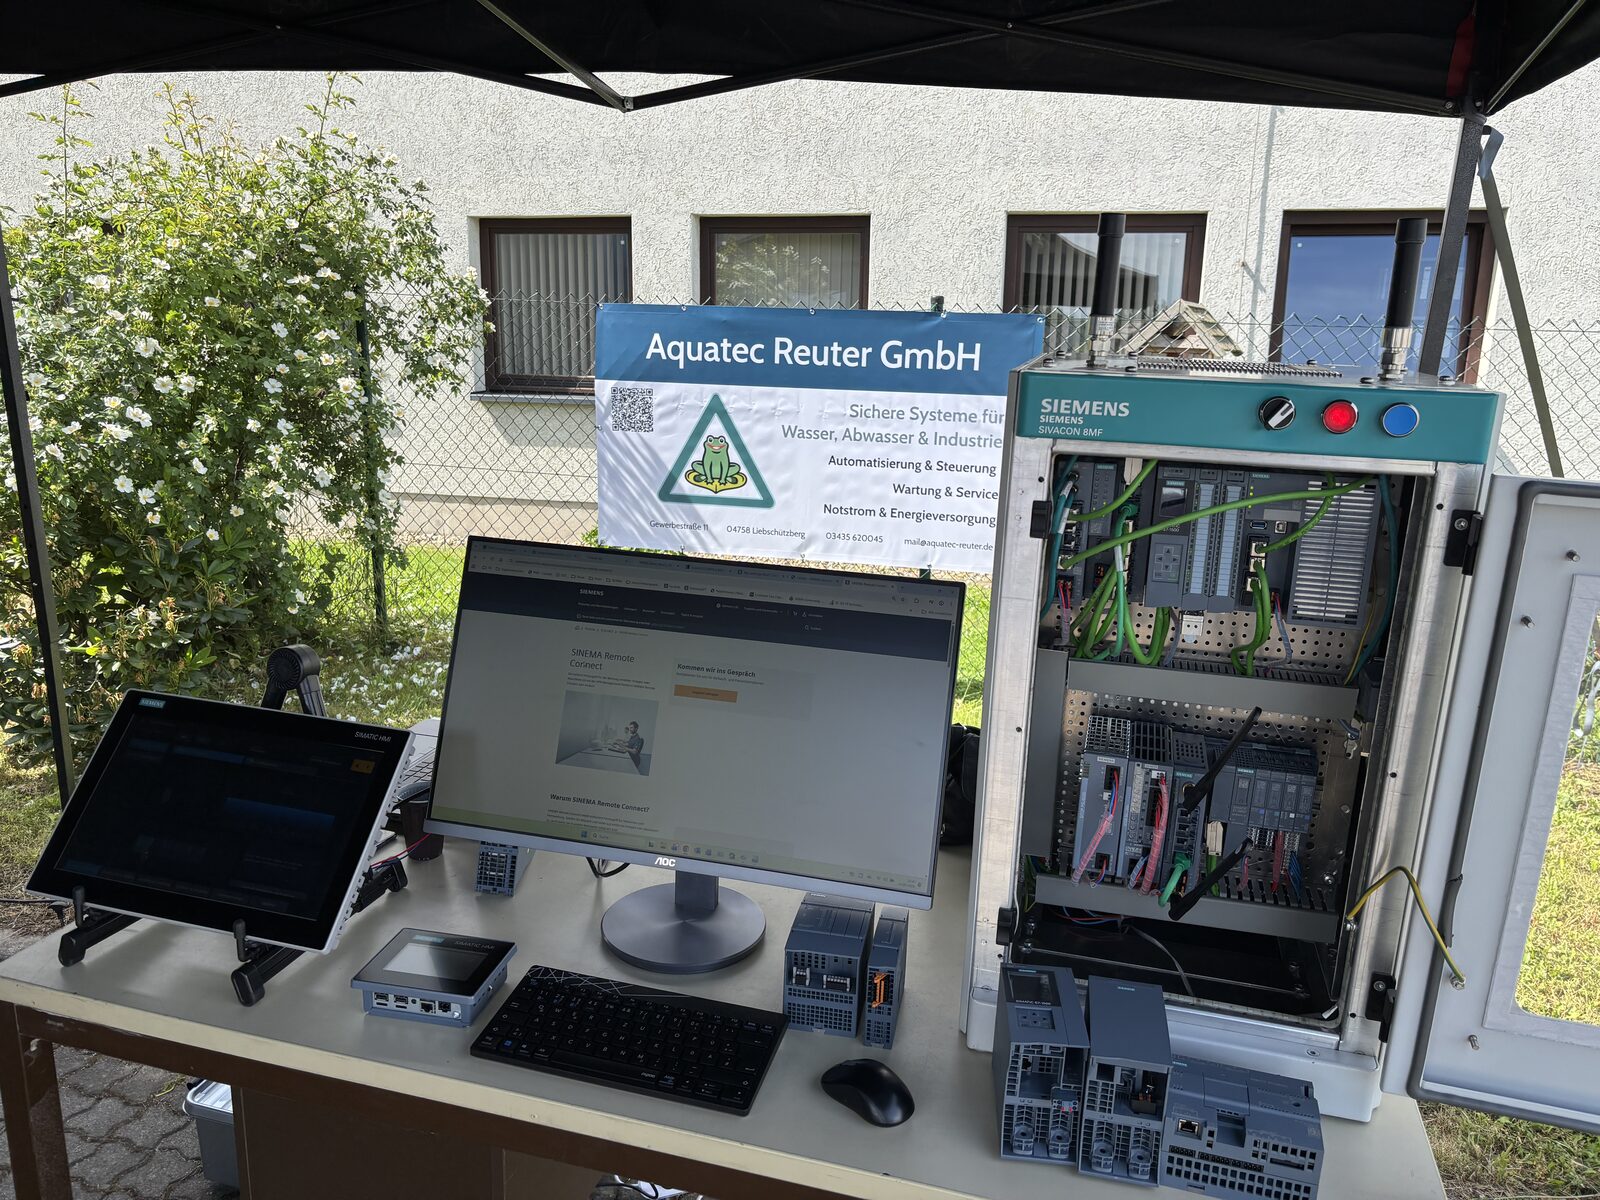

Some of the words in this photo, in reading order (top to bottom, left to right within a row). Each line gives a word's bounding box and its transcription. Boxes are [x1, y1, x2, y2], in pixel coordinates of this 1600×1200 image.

[645, 333, 765, 370] Aquatec
[774, 336, 873, 368] Reuter
[880, 339, 981, 372] GmbH
[850, 403, 905, 420] Sichere
[909, 406, 978, 425] Systeme
[982, 408, 1005, 425] für
[1040, 398, 1130, 418] SIEMENS
[1039, 414, 1084, 425] SIEMENS
[782, 424, 838, 443] Wasser,
[842, 427, 915, 445] Abwasser
[918, 431, 929, 446] &
[933, 431, 1003, 449] Industrie
[1038, 425, 1081, 436] SIVACON
[1083, 427, 1103, 437] 8MF
[828, 455, 922, 473] Automatisierung
[924, 461, 933, 471] &
[936, 460, 997, 478] Steuerung
[892, 483, 942, 500] Wartung
[944, 486, 953, 497] &
[956, 486, 999, 500] Service
[823, 503, 876, 517] Notstrom
[879, 507, 887, 518] &
[890, 508, 997, 528] Energieversorgung
[649, 520, 702, 531] Gewerbestraße
[726, 525, 751, 534] 04758
[752, 527, 806, 540] Liebschützberg
[825, 532, 851, 541] 03435
[852, 534, 884, 543] 620045
[904, 537, 994, 551] mail@aquatec-reuter.de
[579, 588, 604, 596] SIEMENS
[571, 648, 602, 659] SINEMA
[604, 651, 635, 663] Remote
[569, 659, 603, 671] Connect
[677, 663, 705, 672] Kommen
[727, 668, 756, 678] Gespräch
[354, 731, 379, 741] SIMATIC
[550, 793, 572, 802] Warum
[572, 796, 596, 806] SINEMA
[596, 800, 620, 809] Remote
[621, 803, 650, 813] Connect?
[654, 856, 676, 867] AOC
